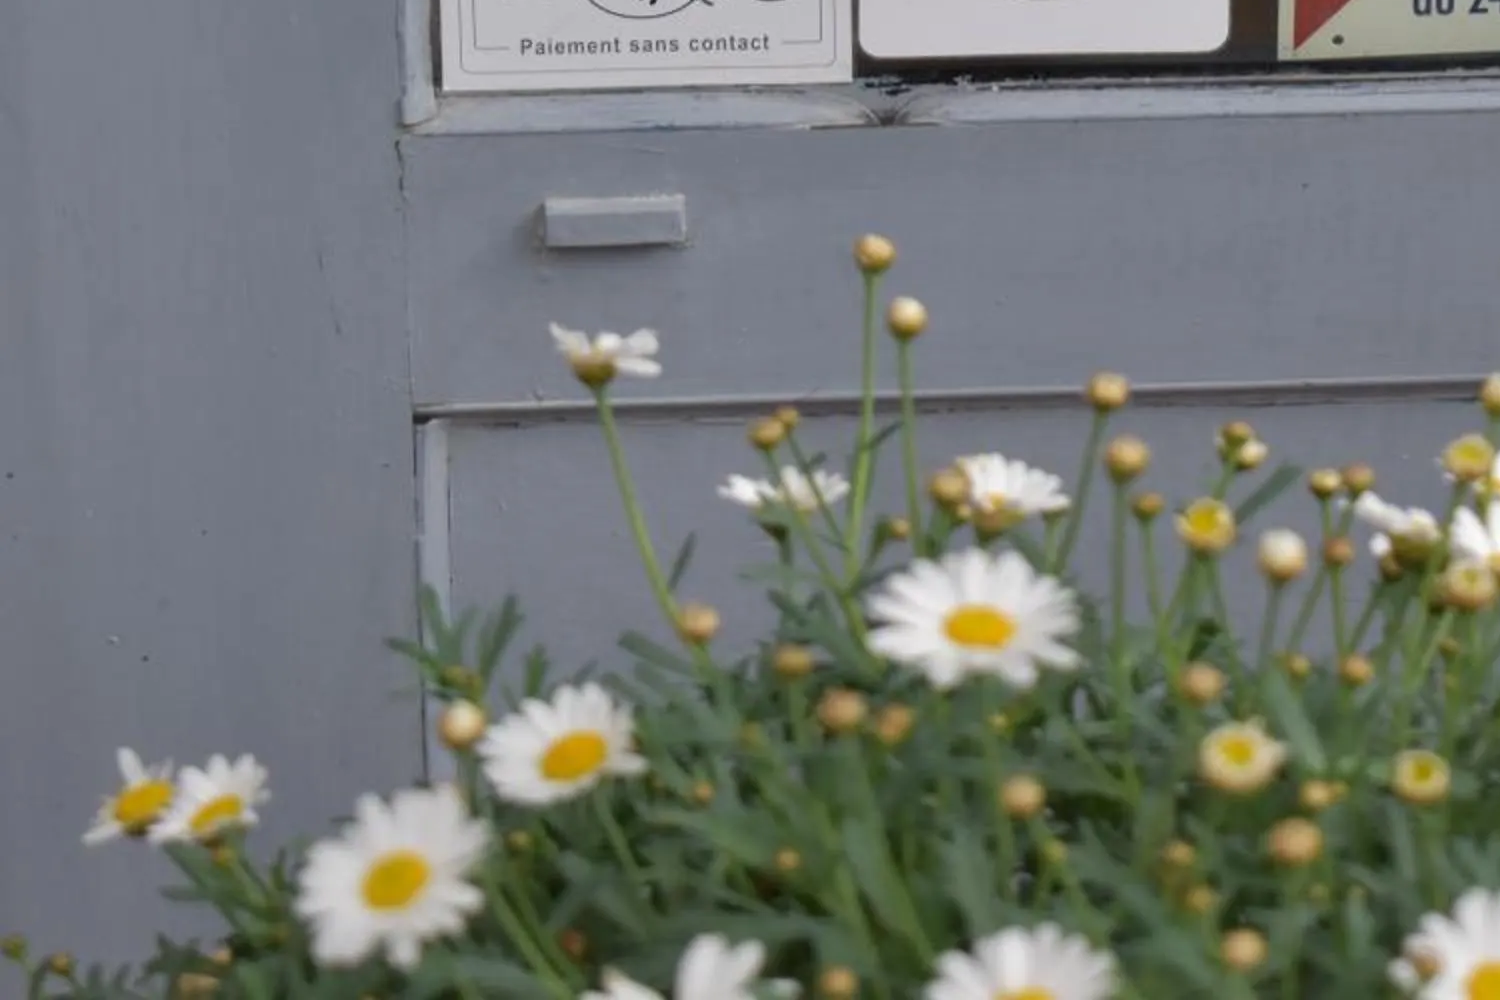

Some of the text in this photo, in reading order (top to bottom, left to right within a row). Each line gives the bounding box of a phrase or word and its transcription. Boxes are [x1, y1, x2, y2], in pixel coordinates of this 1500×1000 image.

[519, 34, 770, 56] Paiement sans contact
